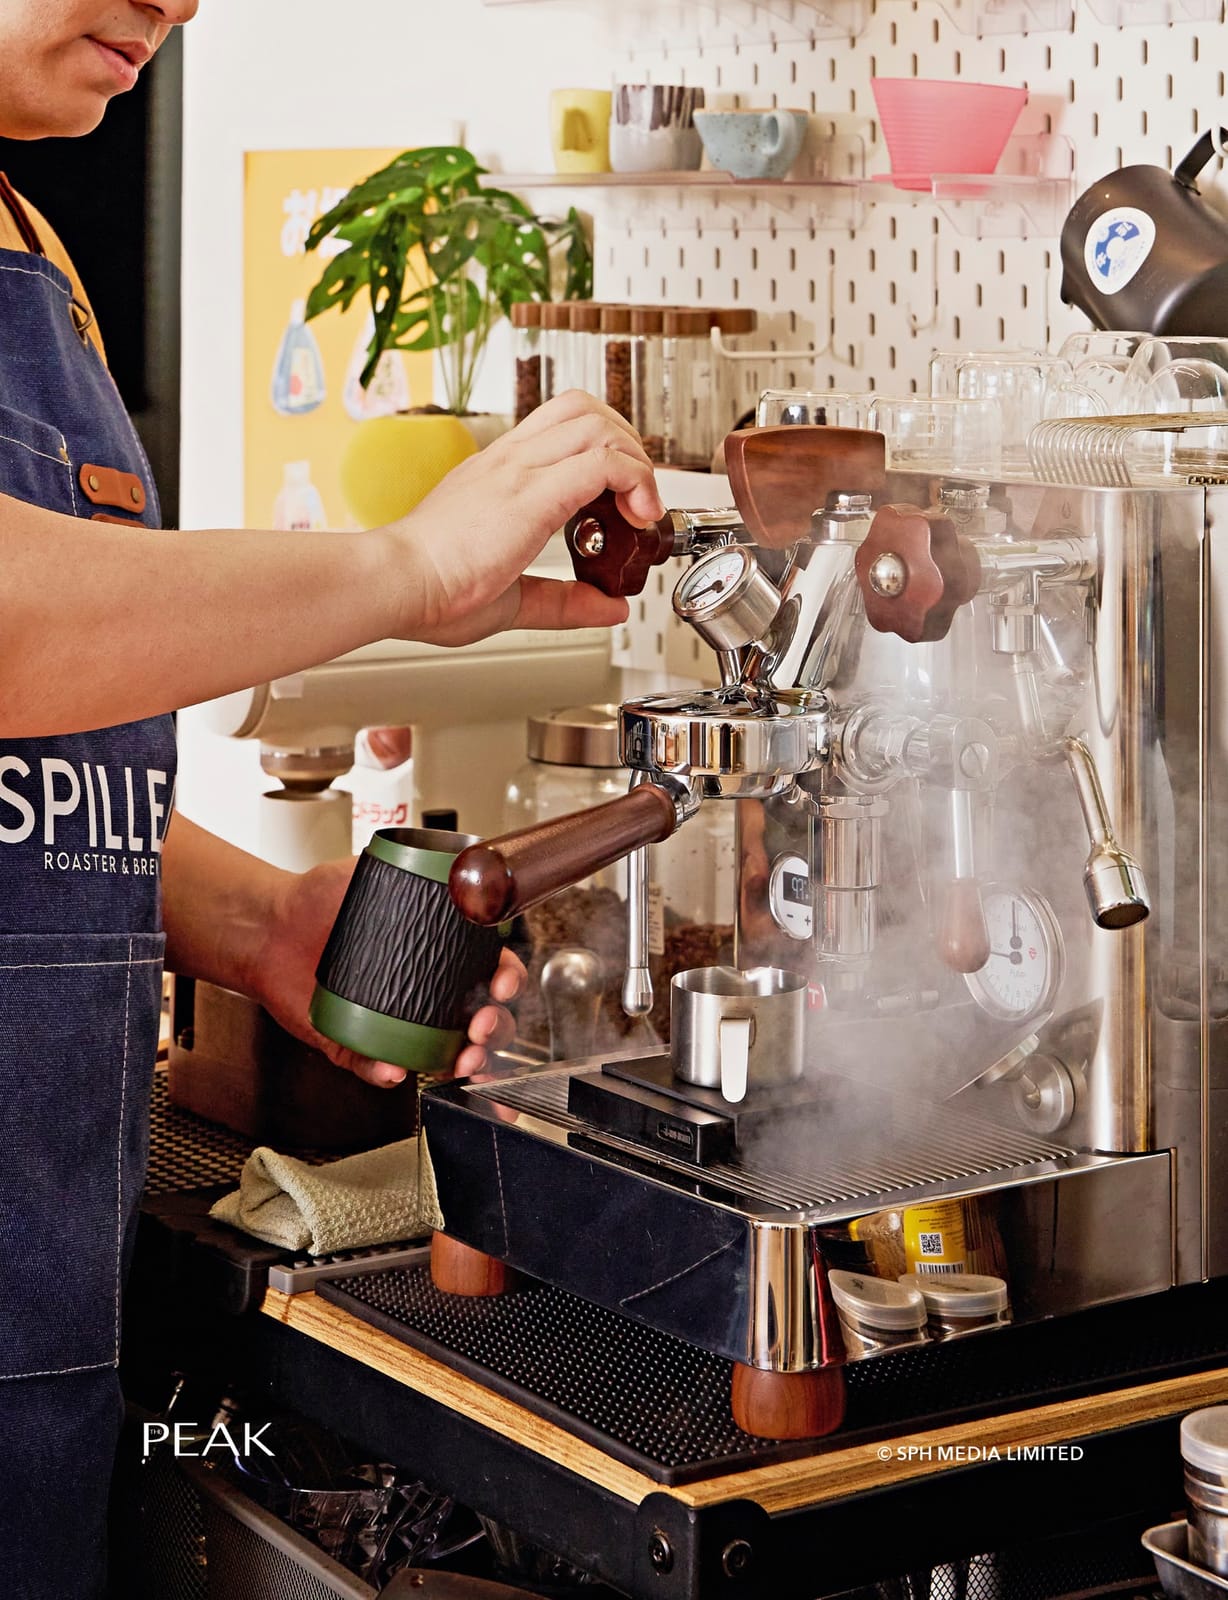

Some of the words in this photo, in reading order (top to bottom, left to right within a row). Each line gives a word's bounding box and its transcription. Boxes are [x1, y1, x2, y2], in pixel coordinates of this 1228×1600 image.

[0, 755, 167, 852] SPILLE
[45, 852, 117, 874] ROASTER
[122, 857, 129, 874] &
[133, 858, 159, 876] BRE
